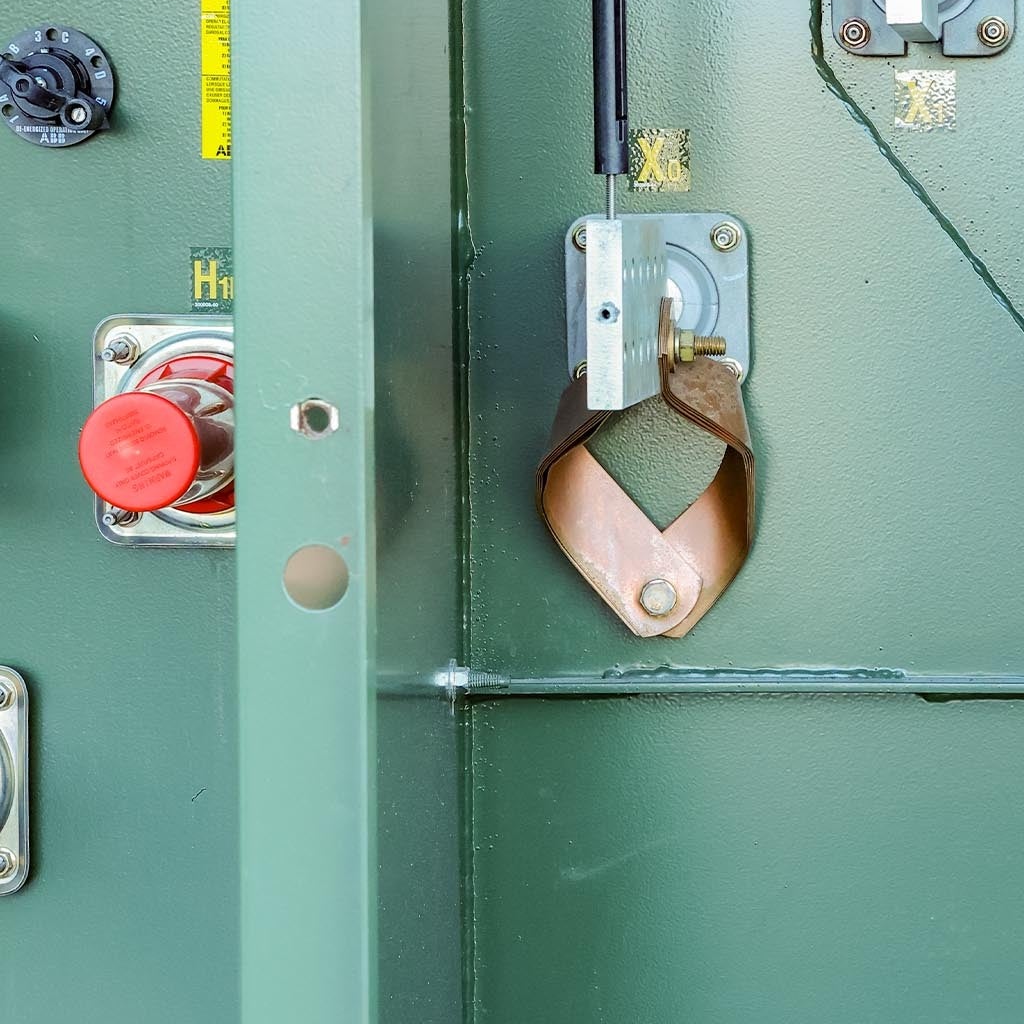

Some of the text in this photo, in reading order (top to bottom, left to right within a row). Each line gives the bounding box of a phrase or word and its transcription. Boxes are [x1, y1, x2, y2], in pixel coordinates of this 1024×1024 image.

[34, 31, 41, 42] 3
[61, 32, 69, 43] C
[9, 43, 20, 54] B
[85, 47, 96, 57] 4
[94, 70, 107, 80] D
[95, 97, 107, 106] 5
[904, 80, 944, 123] X1
[9, 115, 20, 124] 1
[39, 132, 66, 144] ABB
